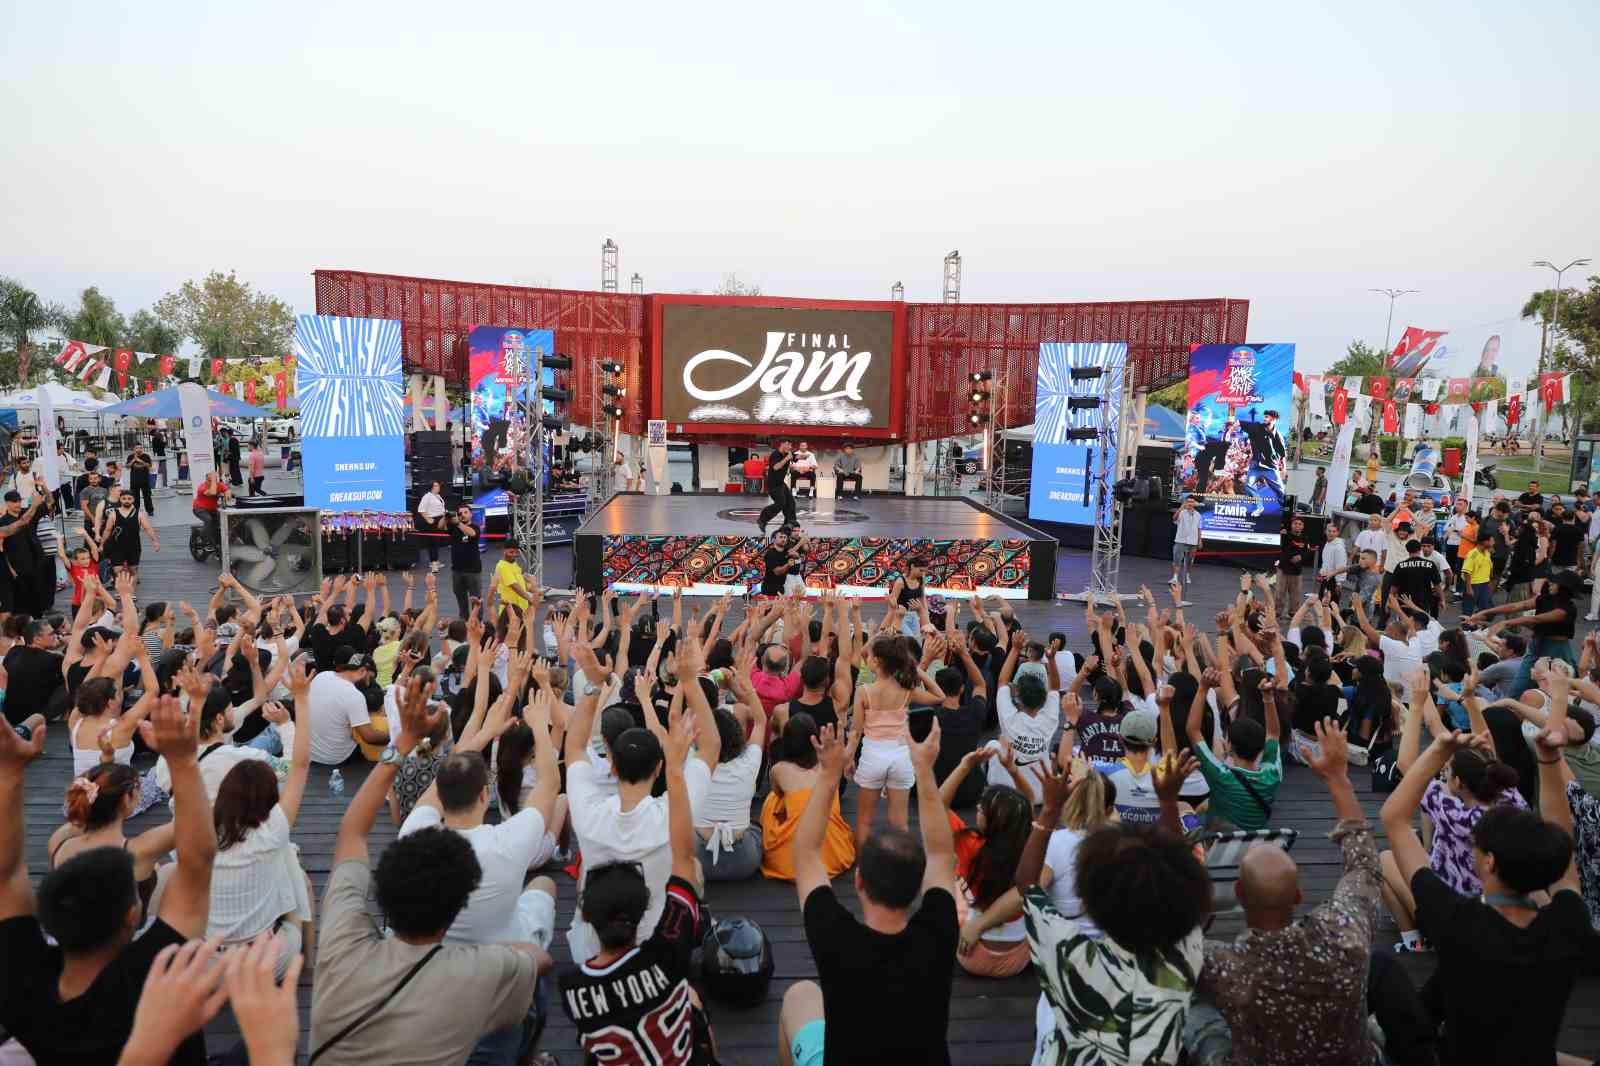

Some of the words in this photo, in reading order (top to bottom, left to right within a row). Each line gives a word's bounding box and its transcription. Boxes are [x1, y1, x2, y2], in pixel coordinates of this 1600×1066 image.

[787, 332, 852, 349] FINAL
[565, 984, 610, 1020] NEW
[611, 963, 671, 1008] YORK
